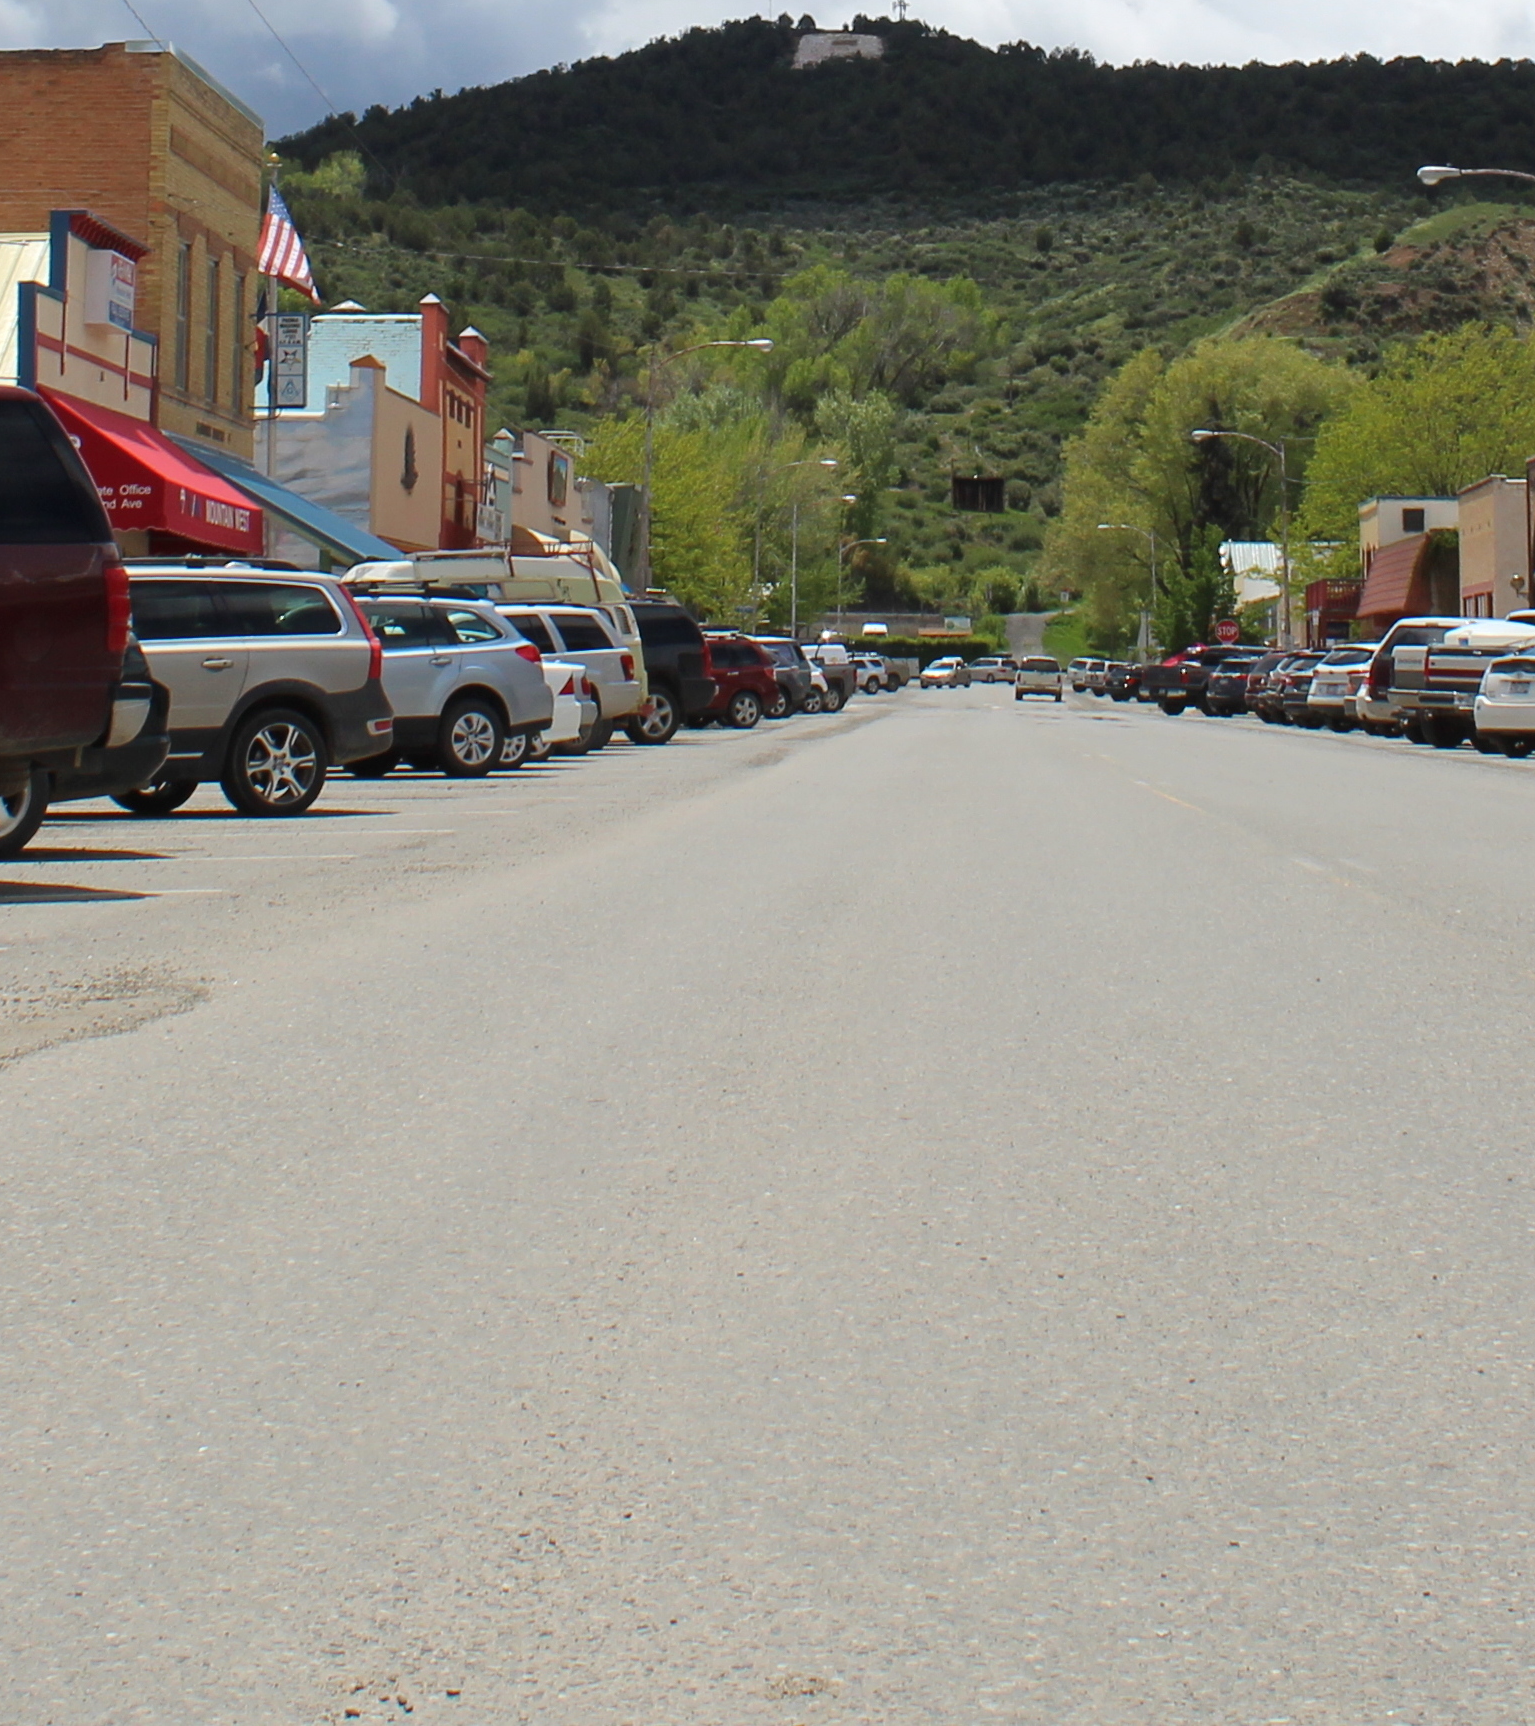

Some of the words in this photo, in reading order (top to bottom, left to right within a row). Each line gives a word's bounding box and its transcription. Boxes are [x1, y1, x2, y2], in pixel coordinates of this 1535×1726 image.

[119, 484, 152, 496] Office
[121, 499, 143, 509] Ave
[1217, 626, 1238, 636] STOP
